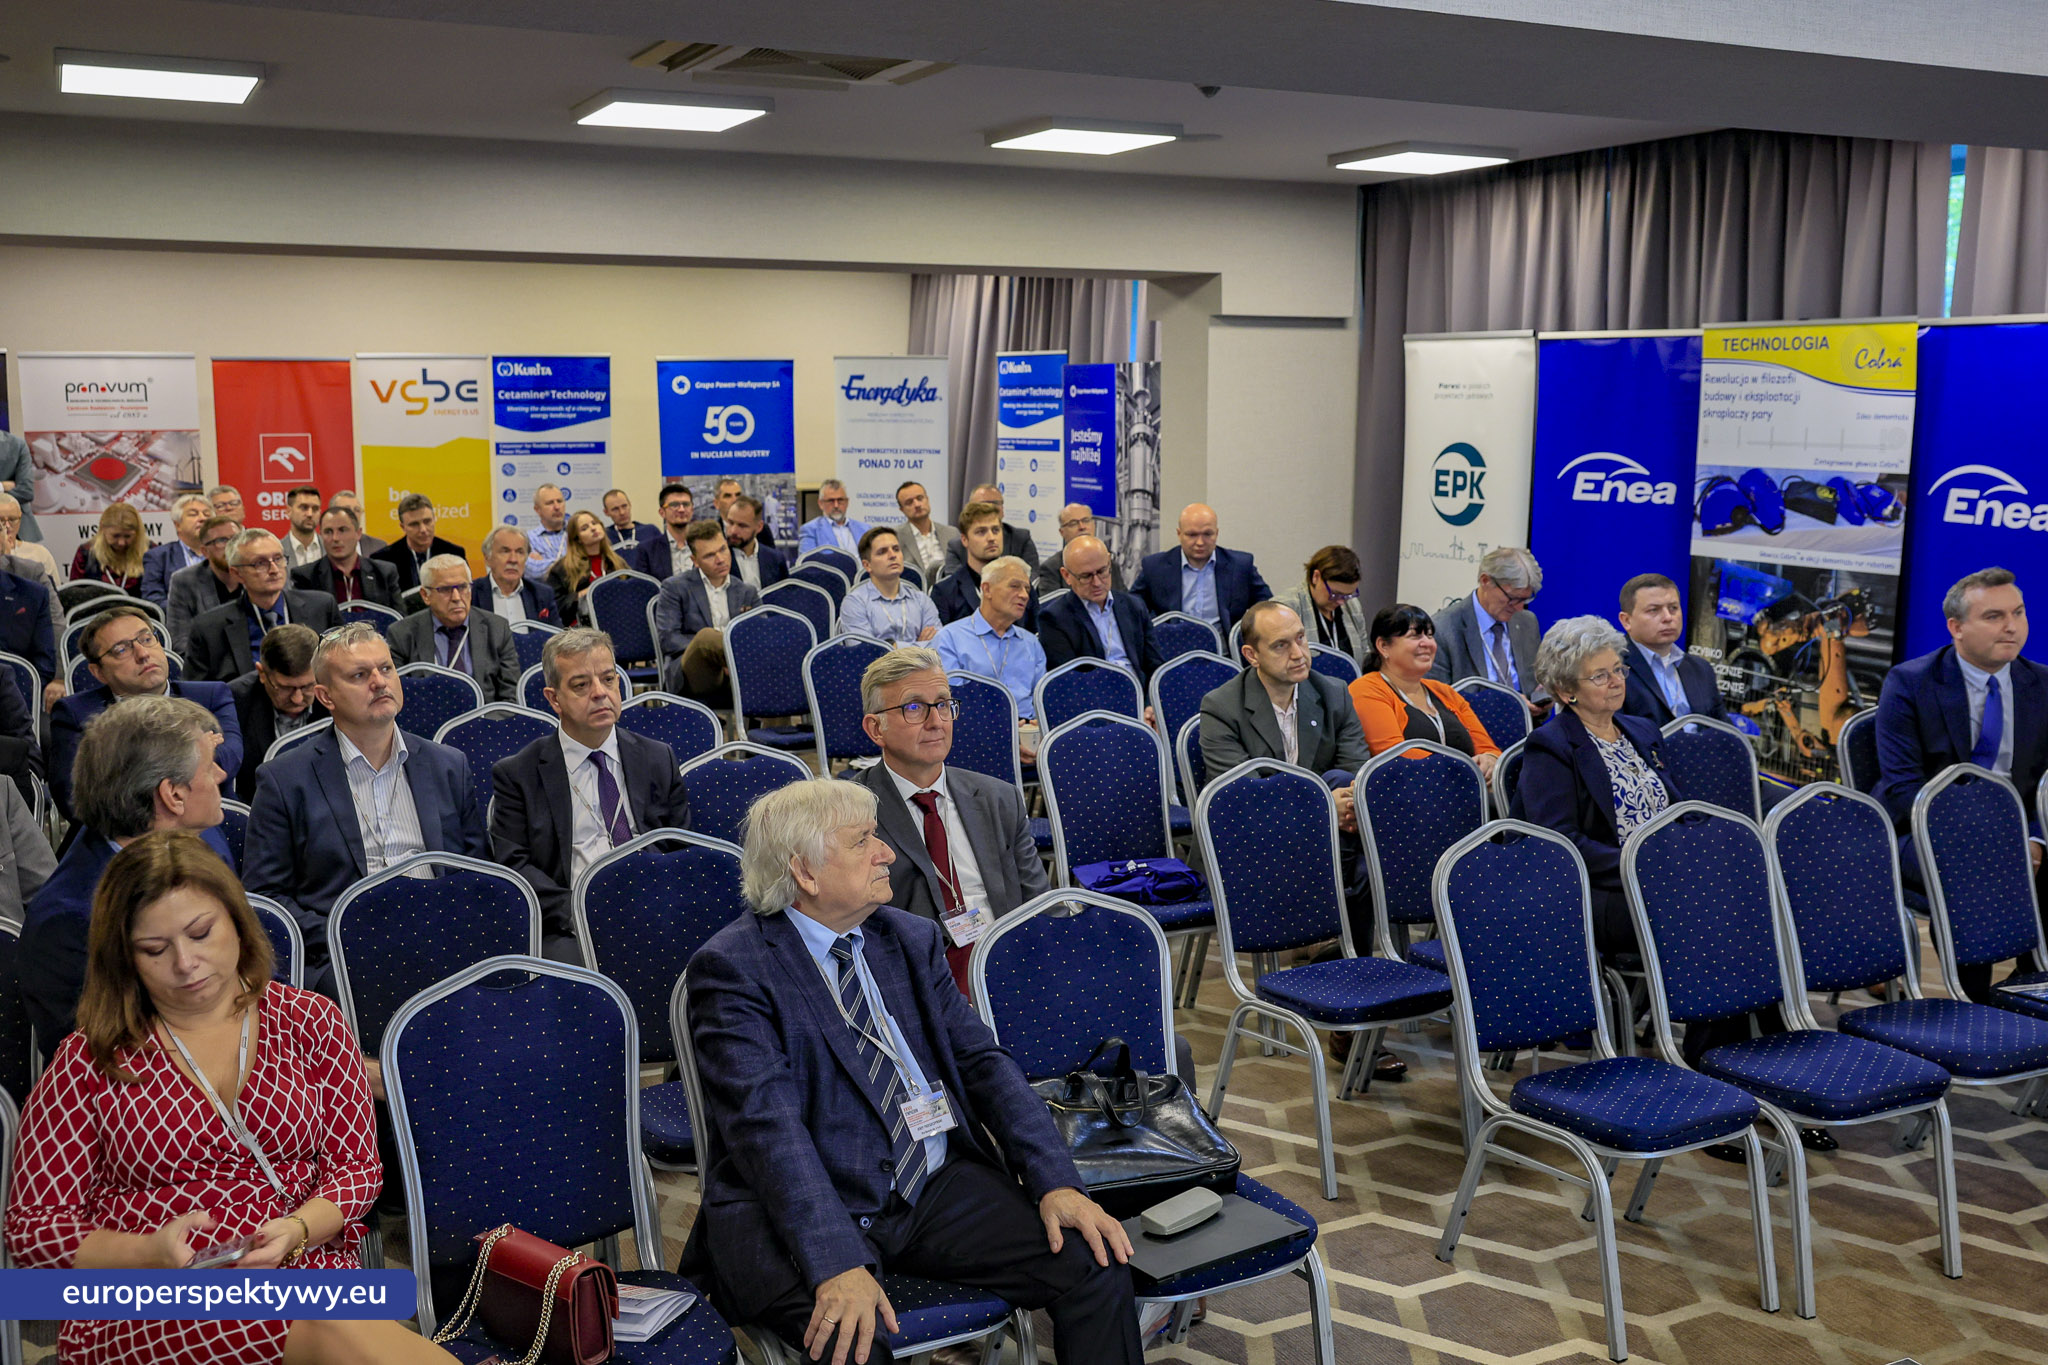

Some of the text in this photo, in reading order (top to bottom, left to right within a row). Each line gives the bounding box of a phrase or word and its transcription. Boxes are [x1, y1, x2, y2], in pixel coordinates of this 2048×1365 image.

[1722, 336, 1830, 352] TECHNOLOGIA
[1704, 373, 1750, 387] Rewolucja
[1761, 373, 1797, 385] filozofii
[550, 390, 607, 402] Technology
[841, 375, 938, 407] Energetyka
[1704, 392, 1737, 404] budowy
[1703, 409, 1774, 420] skraplaczy pary
[702, 405, 755, 445] 50
[700, 450, 733, 459] NUCLEAR
[734, 449, 770, 458] INDUSTRY
[859, 459, 924, 469] PONAD 70 LAT
[1435, 469, 1486, 500] EPK
[1572, 472, 1677, 505] Enea
[1943, 488, 2048, 532] Enea
[1688, 645, 1722, 659] SZYBKO
